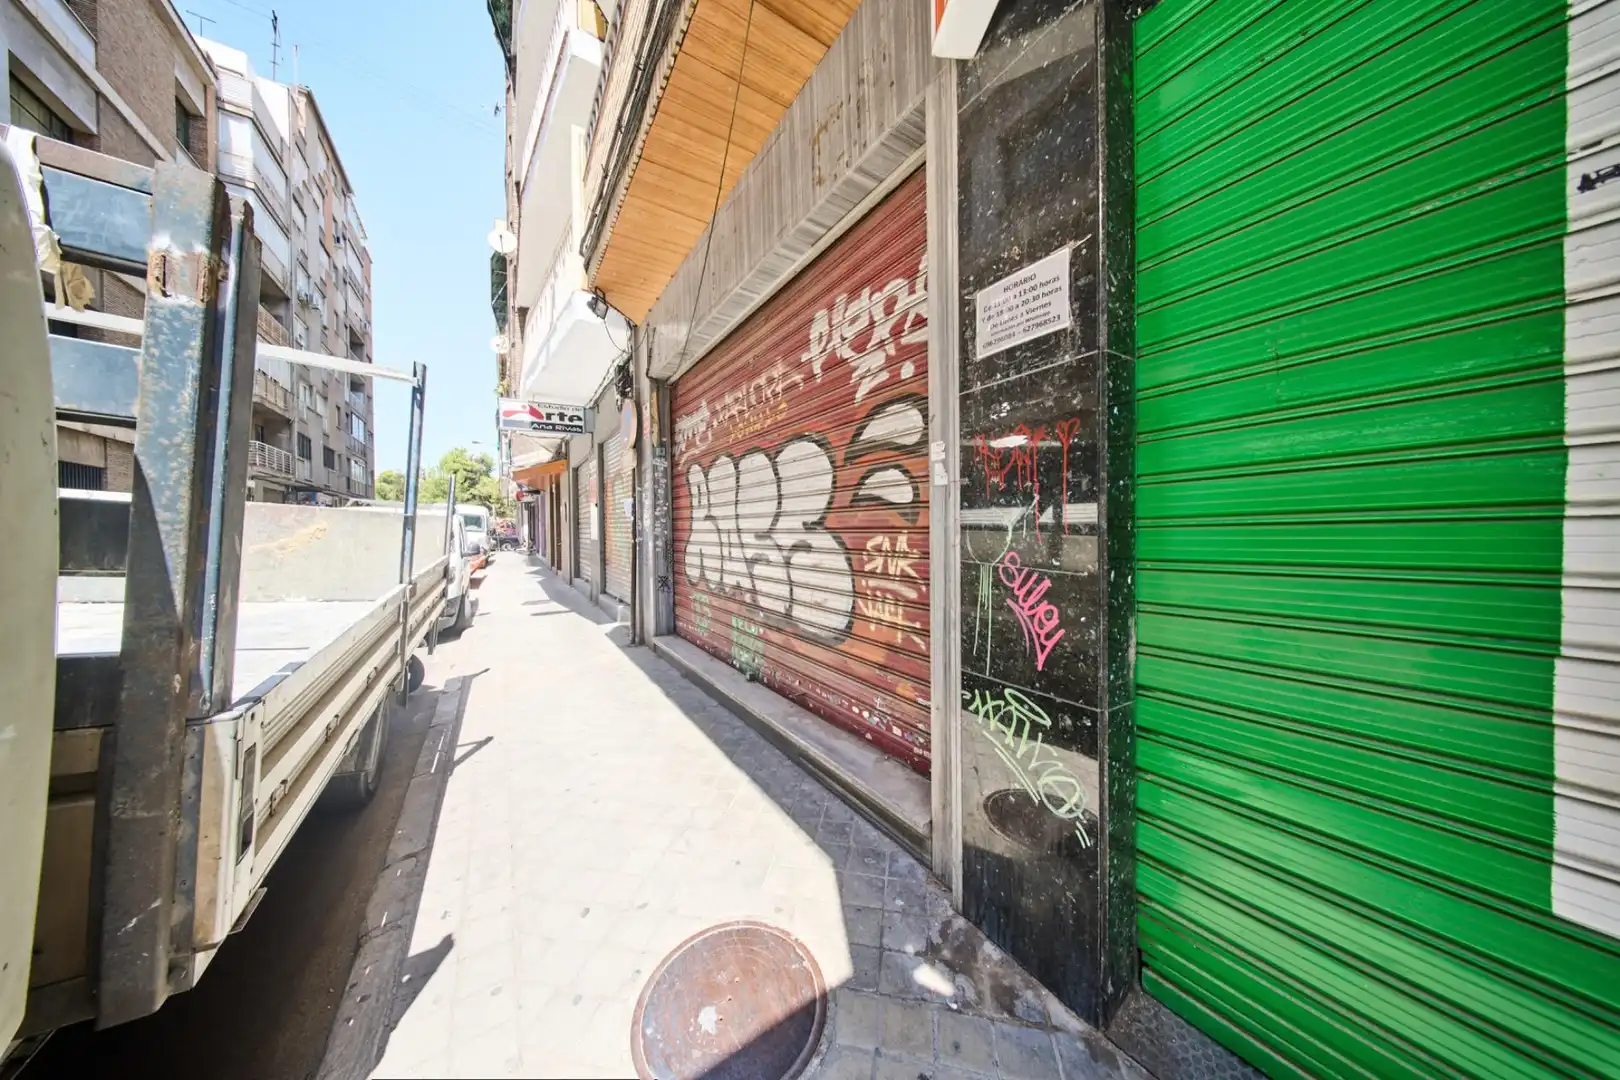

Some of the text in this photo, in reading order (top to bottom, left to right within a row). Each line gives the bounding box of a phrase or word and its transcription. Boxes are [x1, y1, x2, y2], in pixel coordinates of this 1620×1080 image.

[1003, 272, 1037, 293] HORARIO
[1039, 275, 1061, 288] horas
[1041, 286, 1062, 299] horas
[1025, 301, 1052, 315] Viernes
[531, 422, 583, 432] Ana Rivas
